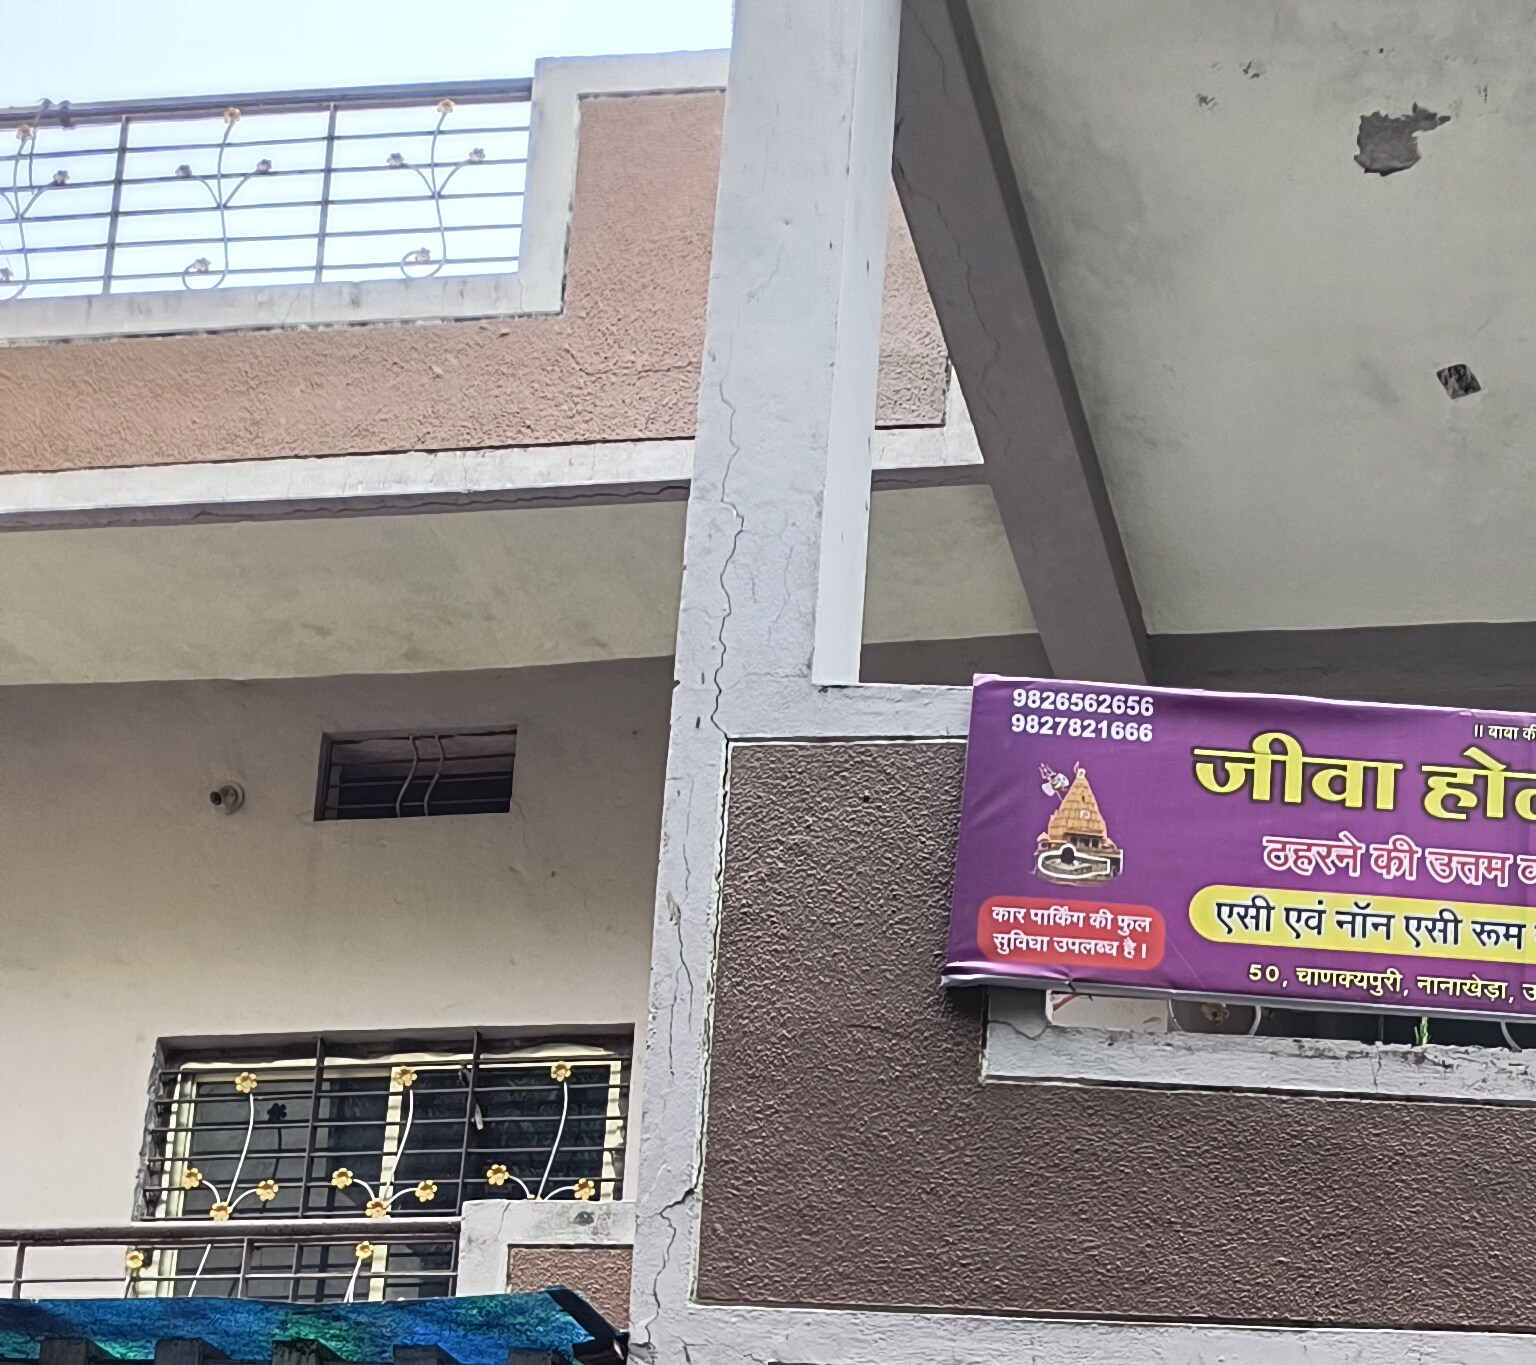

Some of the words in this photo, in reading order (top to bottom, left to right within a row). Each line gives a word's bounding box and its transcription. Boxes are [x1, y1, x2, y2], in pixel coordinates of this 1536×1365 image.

[1012, 688, 1154, 717] 9826562656
[1011, 713, 1153, 742] 9827821666
[1193, 732, 1404, 810] जीवा
[1262, 831, 1366, 877] ठहरने
[1369, 834, 1421, 881] की
[1425, 848, 1513, 887] उत्तम
[991, 906, 1026, 924] कार
[1089, 908, 1114, 930] की
[1117, 915, 1152, 936] फुल
[1215, 894, 1276, 934] एसी
[1283, 899, 1327, 939] एवं
[1335, 901, 1396, 941] नॉन
[1403, 908, 1463, 948] एसी
[1471, 920, 1527, 951] रूम
[1249, 963, 1288, 988] 50,
[1295, 967, 1409, 997] चाणक्यपुरी,
